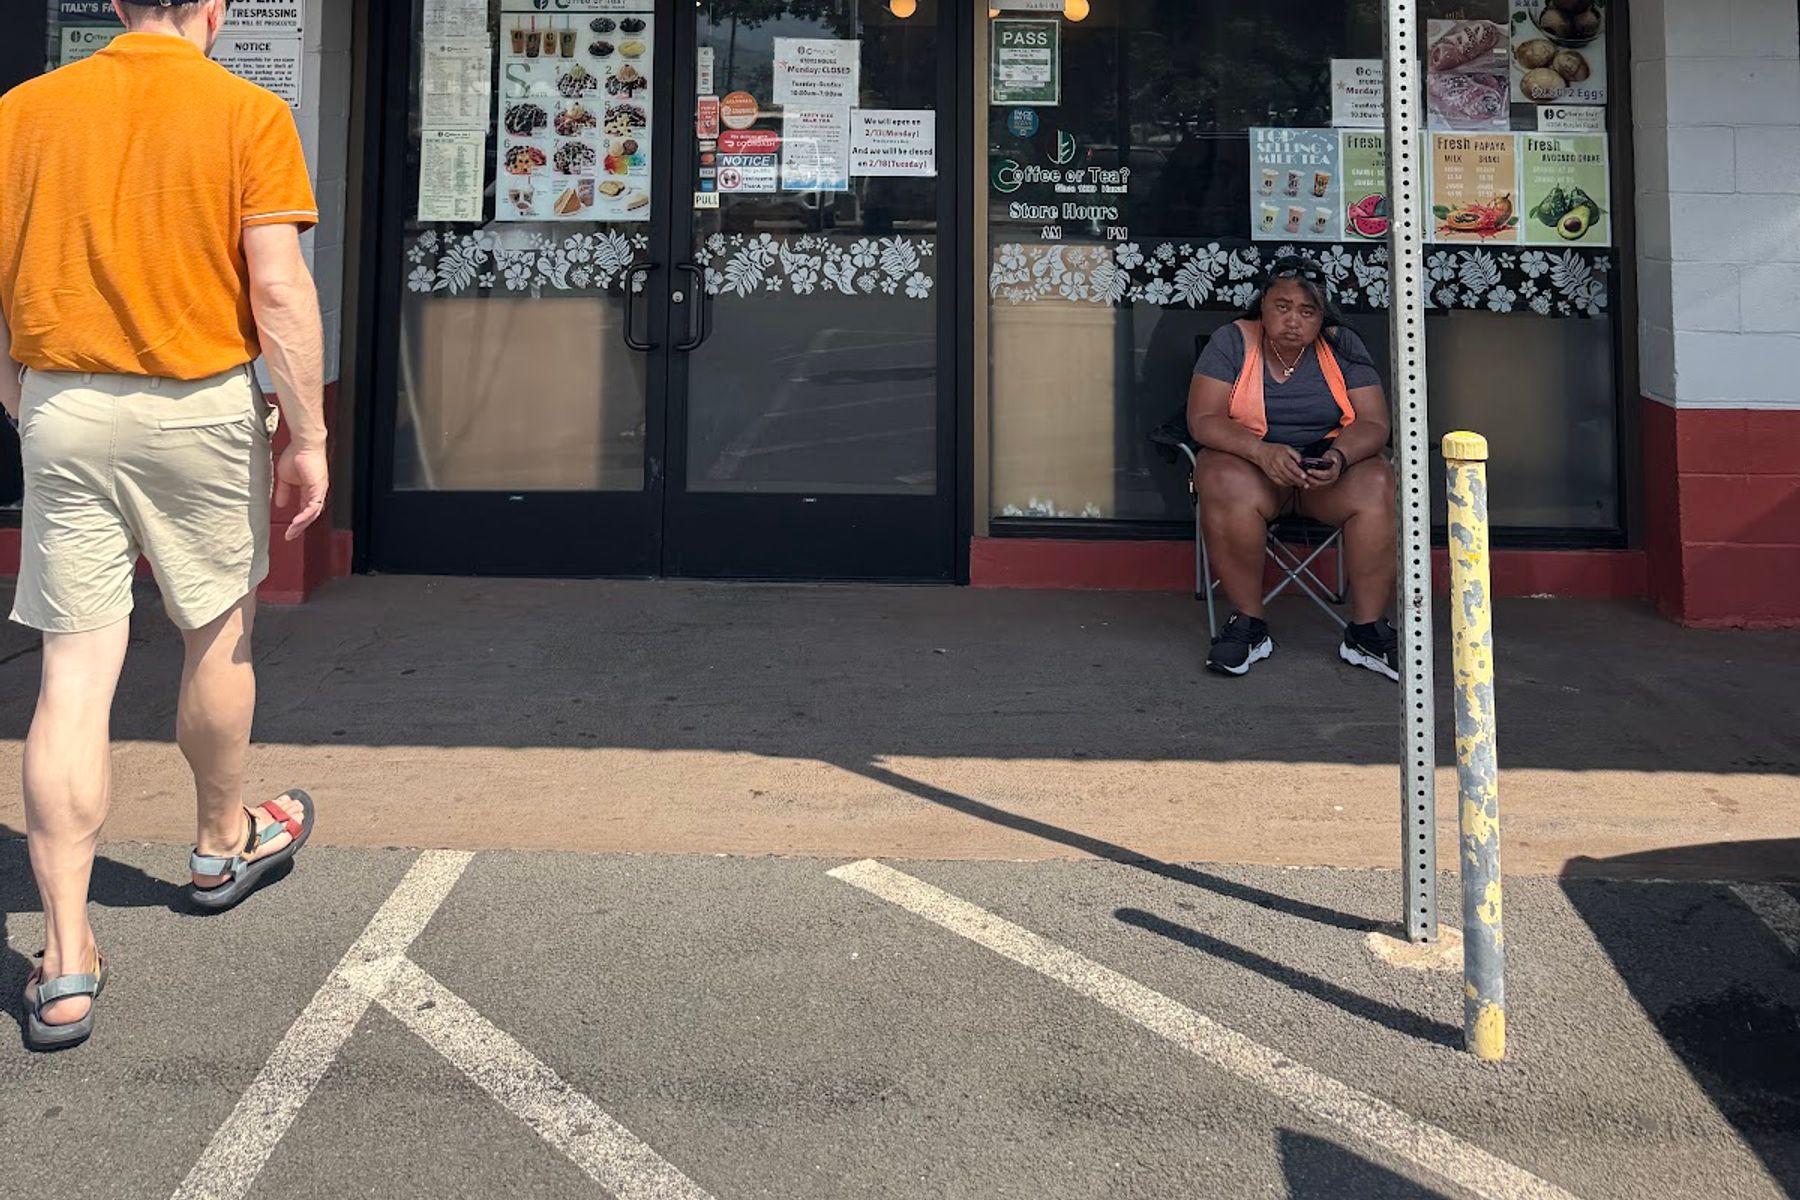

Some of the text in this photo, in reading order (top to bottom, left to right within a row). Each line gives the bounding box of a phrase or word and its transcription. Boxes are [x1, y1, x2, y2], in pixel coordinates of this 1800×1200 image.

[61, 3, 98, 13] ITALY'S
[232, 9, 297, 18] TRESPASSING
[1003, 31, 1048, 45] PASS
[234, 42, 271, 51] NOTICE
[787, 66, 851, 74] Monday: CLOSED
[1345, 87, 1381, 95] Monday:
[1577, 89, 1604, 100] Eggs
[1257, 129, 1296, 142] TOP
[1347, 135, 1382, 149] Fresh
[1437, 137, 1506, 151] Fresh PAPAYA
[1528, 138, 1561, 151] Fresh
[909, 147, 933, 155] closed
[1257, 143, 1322, 154] SELLING
[723, 156, 770, 166] NOTICE
[1257, 154, 1331, 165] MILK TEA
[1444, 154, 1462, 163] MILK
[1542, 154, 1576, 162] AVOCADO
[992, 159, 1130, 193] Coffee or Tea?
[696, 194, 718, 205] PULL
[1009, 201, 1119, 220] Store Hours
[1041, 226, 1128, 240] AM PM
